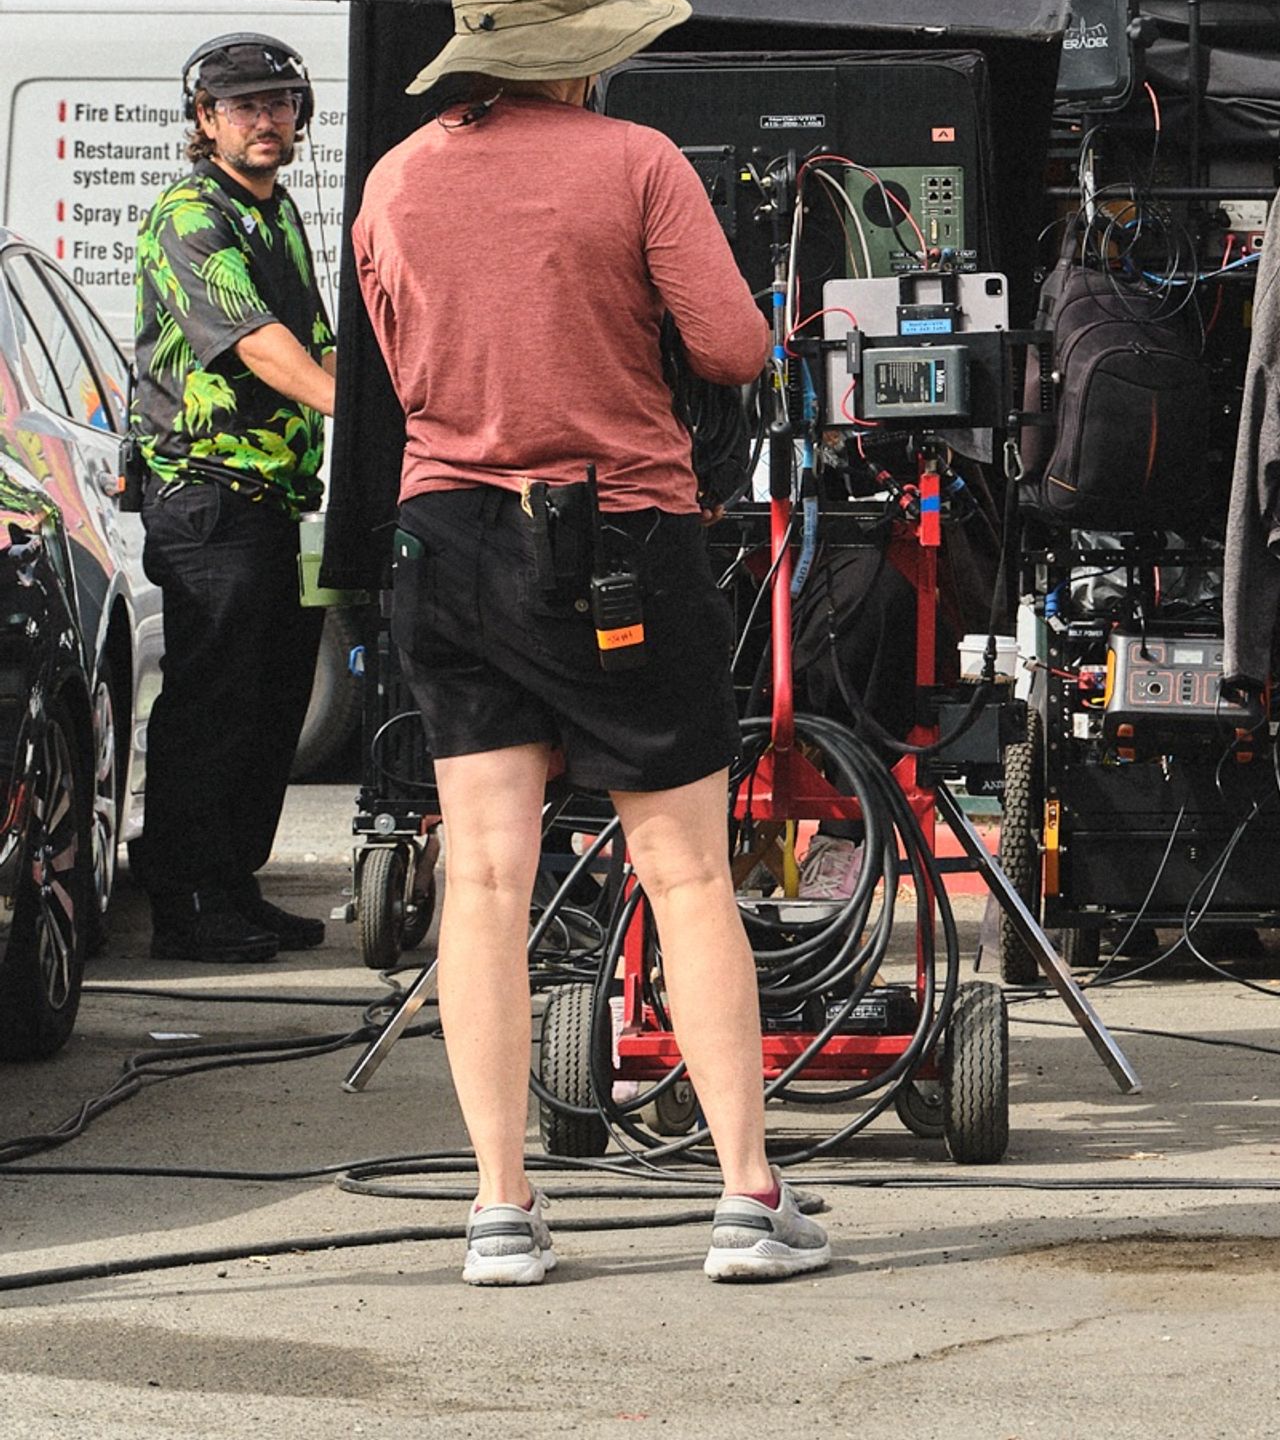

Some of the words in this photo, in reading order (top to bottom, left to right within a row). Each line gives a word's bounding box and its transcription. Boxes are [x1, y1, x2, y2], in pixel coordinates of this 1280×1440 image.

[75, 103, 109, 123] Fire
[73, 140, 170, 161] Restaurant
[311, 144, 344, 164] Fire
[73, 168, 135, 189] system
[73, 203, 122, 227] Spray
[73, 242, 108, 261] Fire
[313, 247, 337, 264] nd
